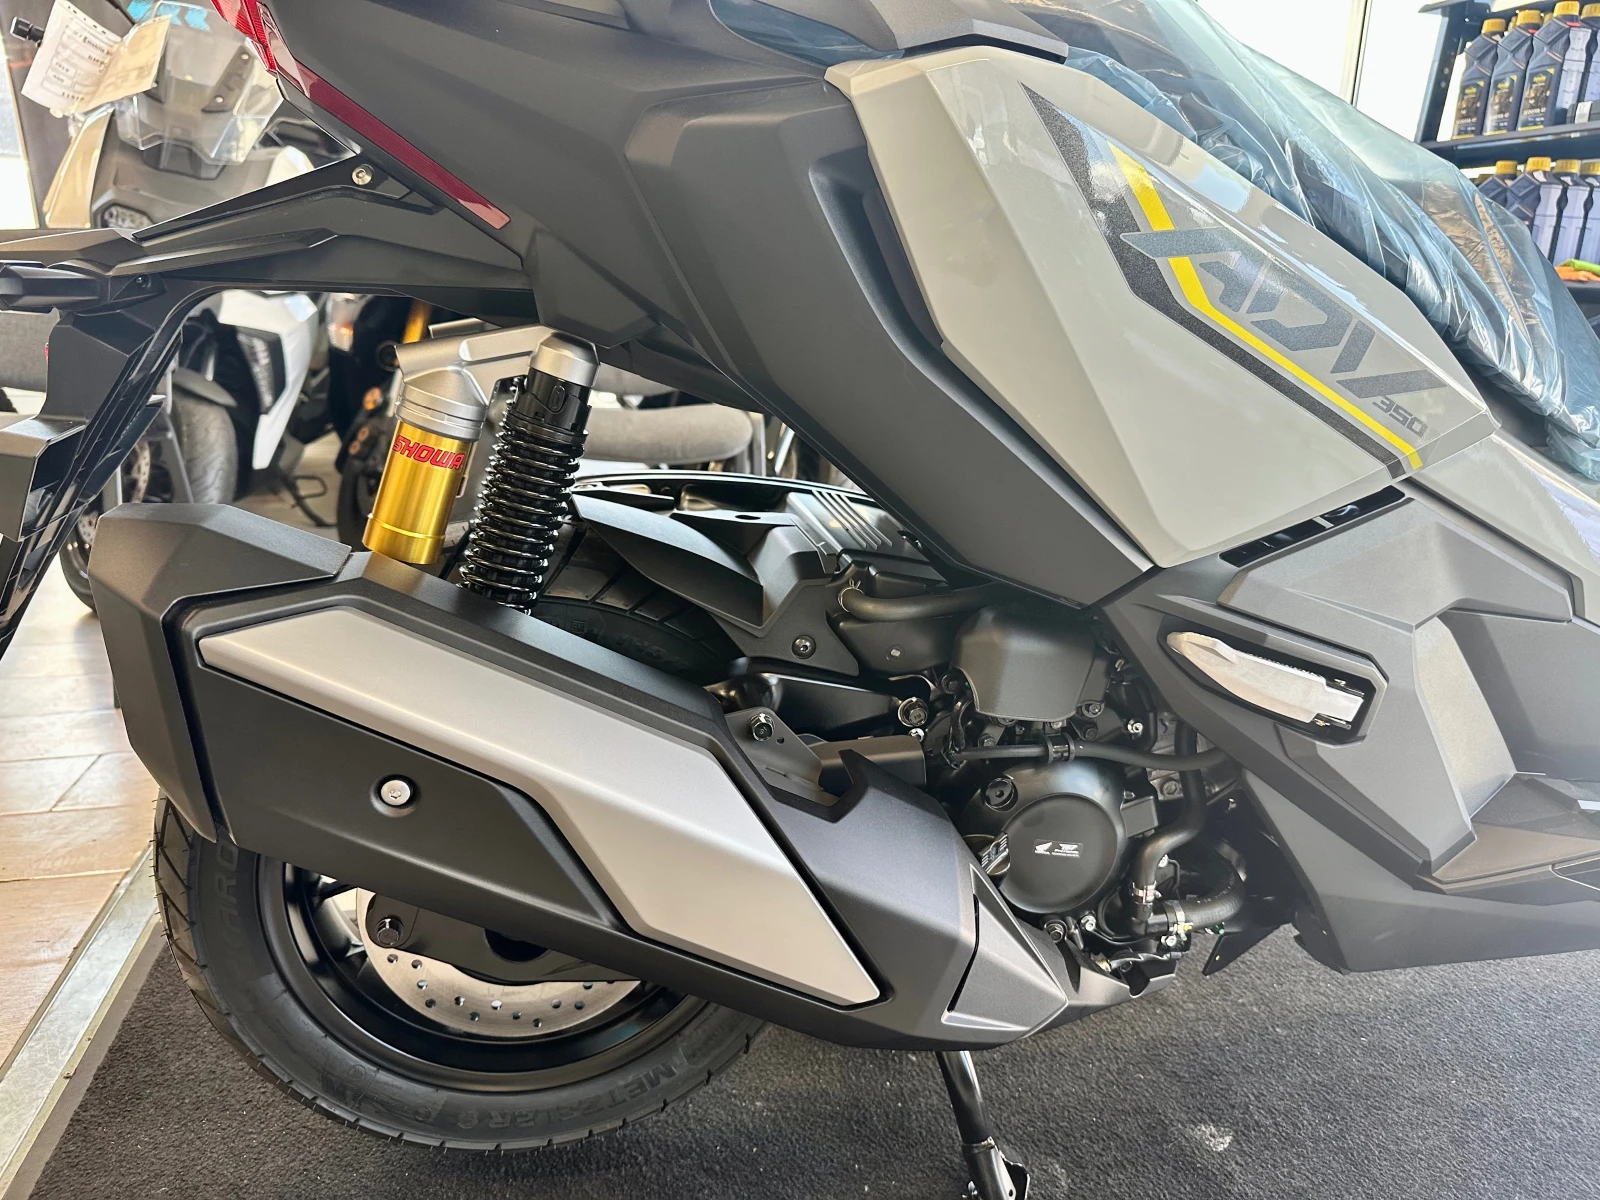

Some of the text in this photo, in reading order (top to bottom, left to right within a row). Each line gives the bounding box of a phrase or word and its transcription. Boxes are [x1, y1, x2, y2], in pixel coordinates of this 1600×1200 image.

[1120, 226, 1448, 399] ADV
[1371, 394, 1428, 438] 350
[392, 434, 466, 470] SHOWA
